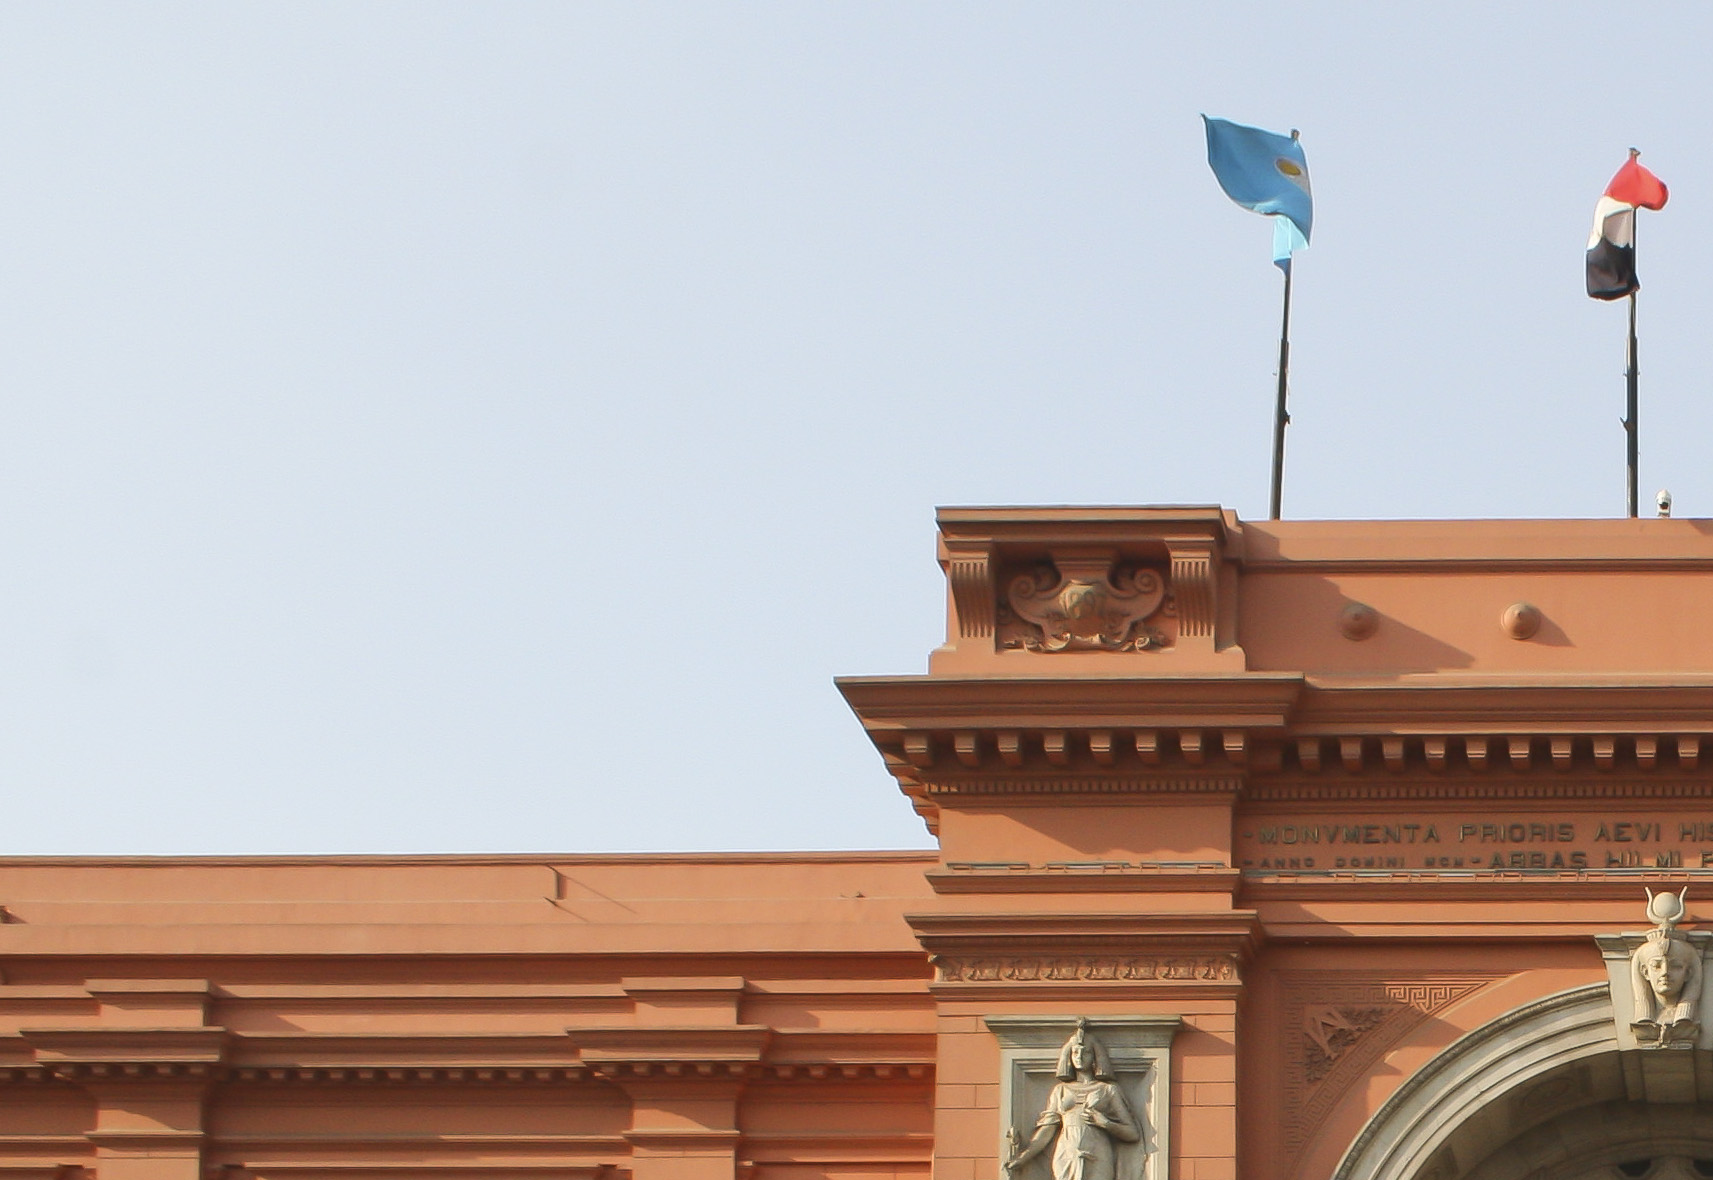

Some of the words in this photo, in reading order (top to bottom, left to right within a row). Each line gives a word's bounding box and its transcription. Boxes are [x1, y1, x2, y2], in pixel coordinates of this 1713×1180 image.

[1259, 823, 1441, 844] MONVMENTA
[1459, 822, 1575, 843] PRIORIS
[1594, 822, 1661, 842] AEVI
[1260, 857, 1316, 868] ANNO
[1489, 851, 1587, 869] ABBAS
